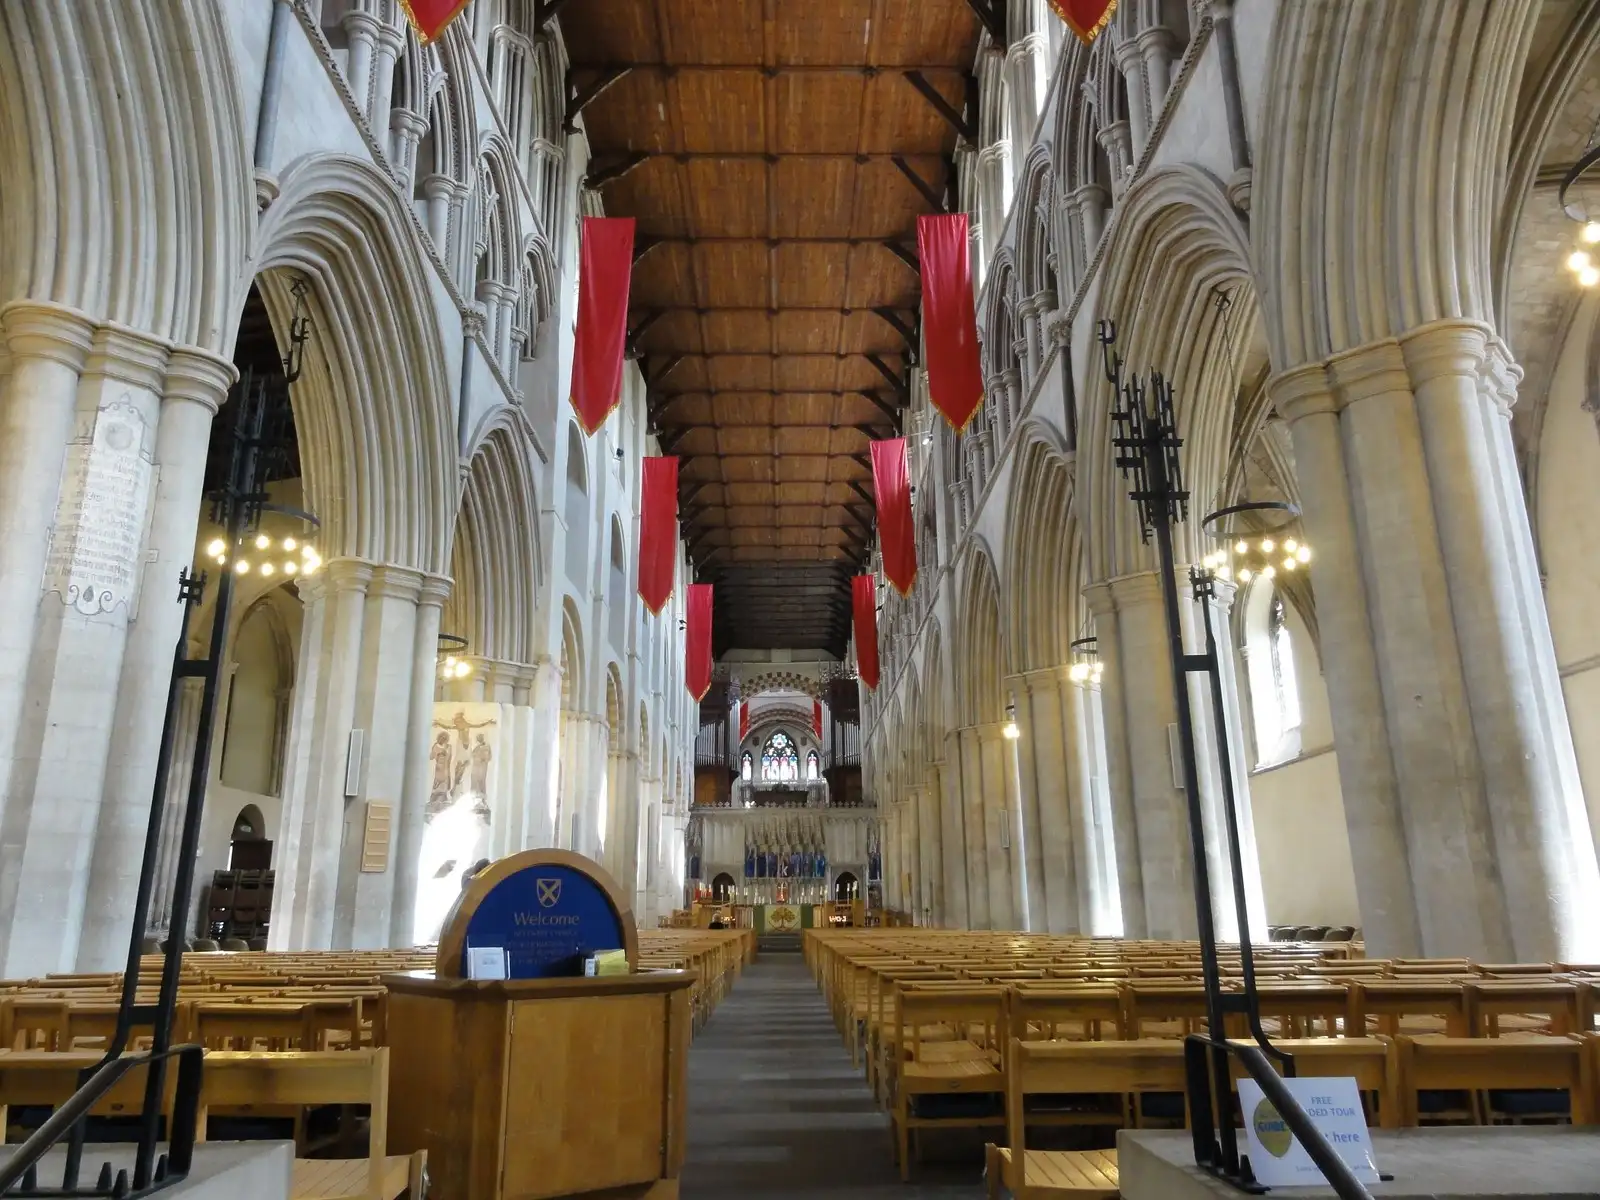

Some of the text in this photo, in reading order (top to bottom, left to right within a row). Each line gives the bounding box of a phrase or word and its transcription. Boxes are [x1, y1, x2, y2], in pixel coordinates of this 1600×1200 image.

[514, 911, 580, 926] Welcome
[1311, 1096, 1332, 1105] FREE
[1329, 1107, 1356, 1117] TOUR
[1333, 1132, 1360, 1143] here
